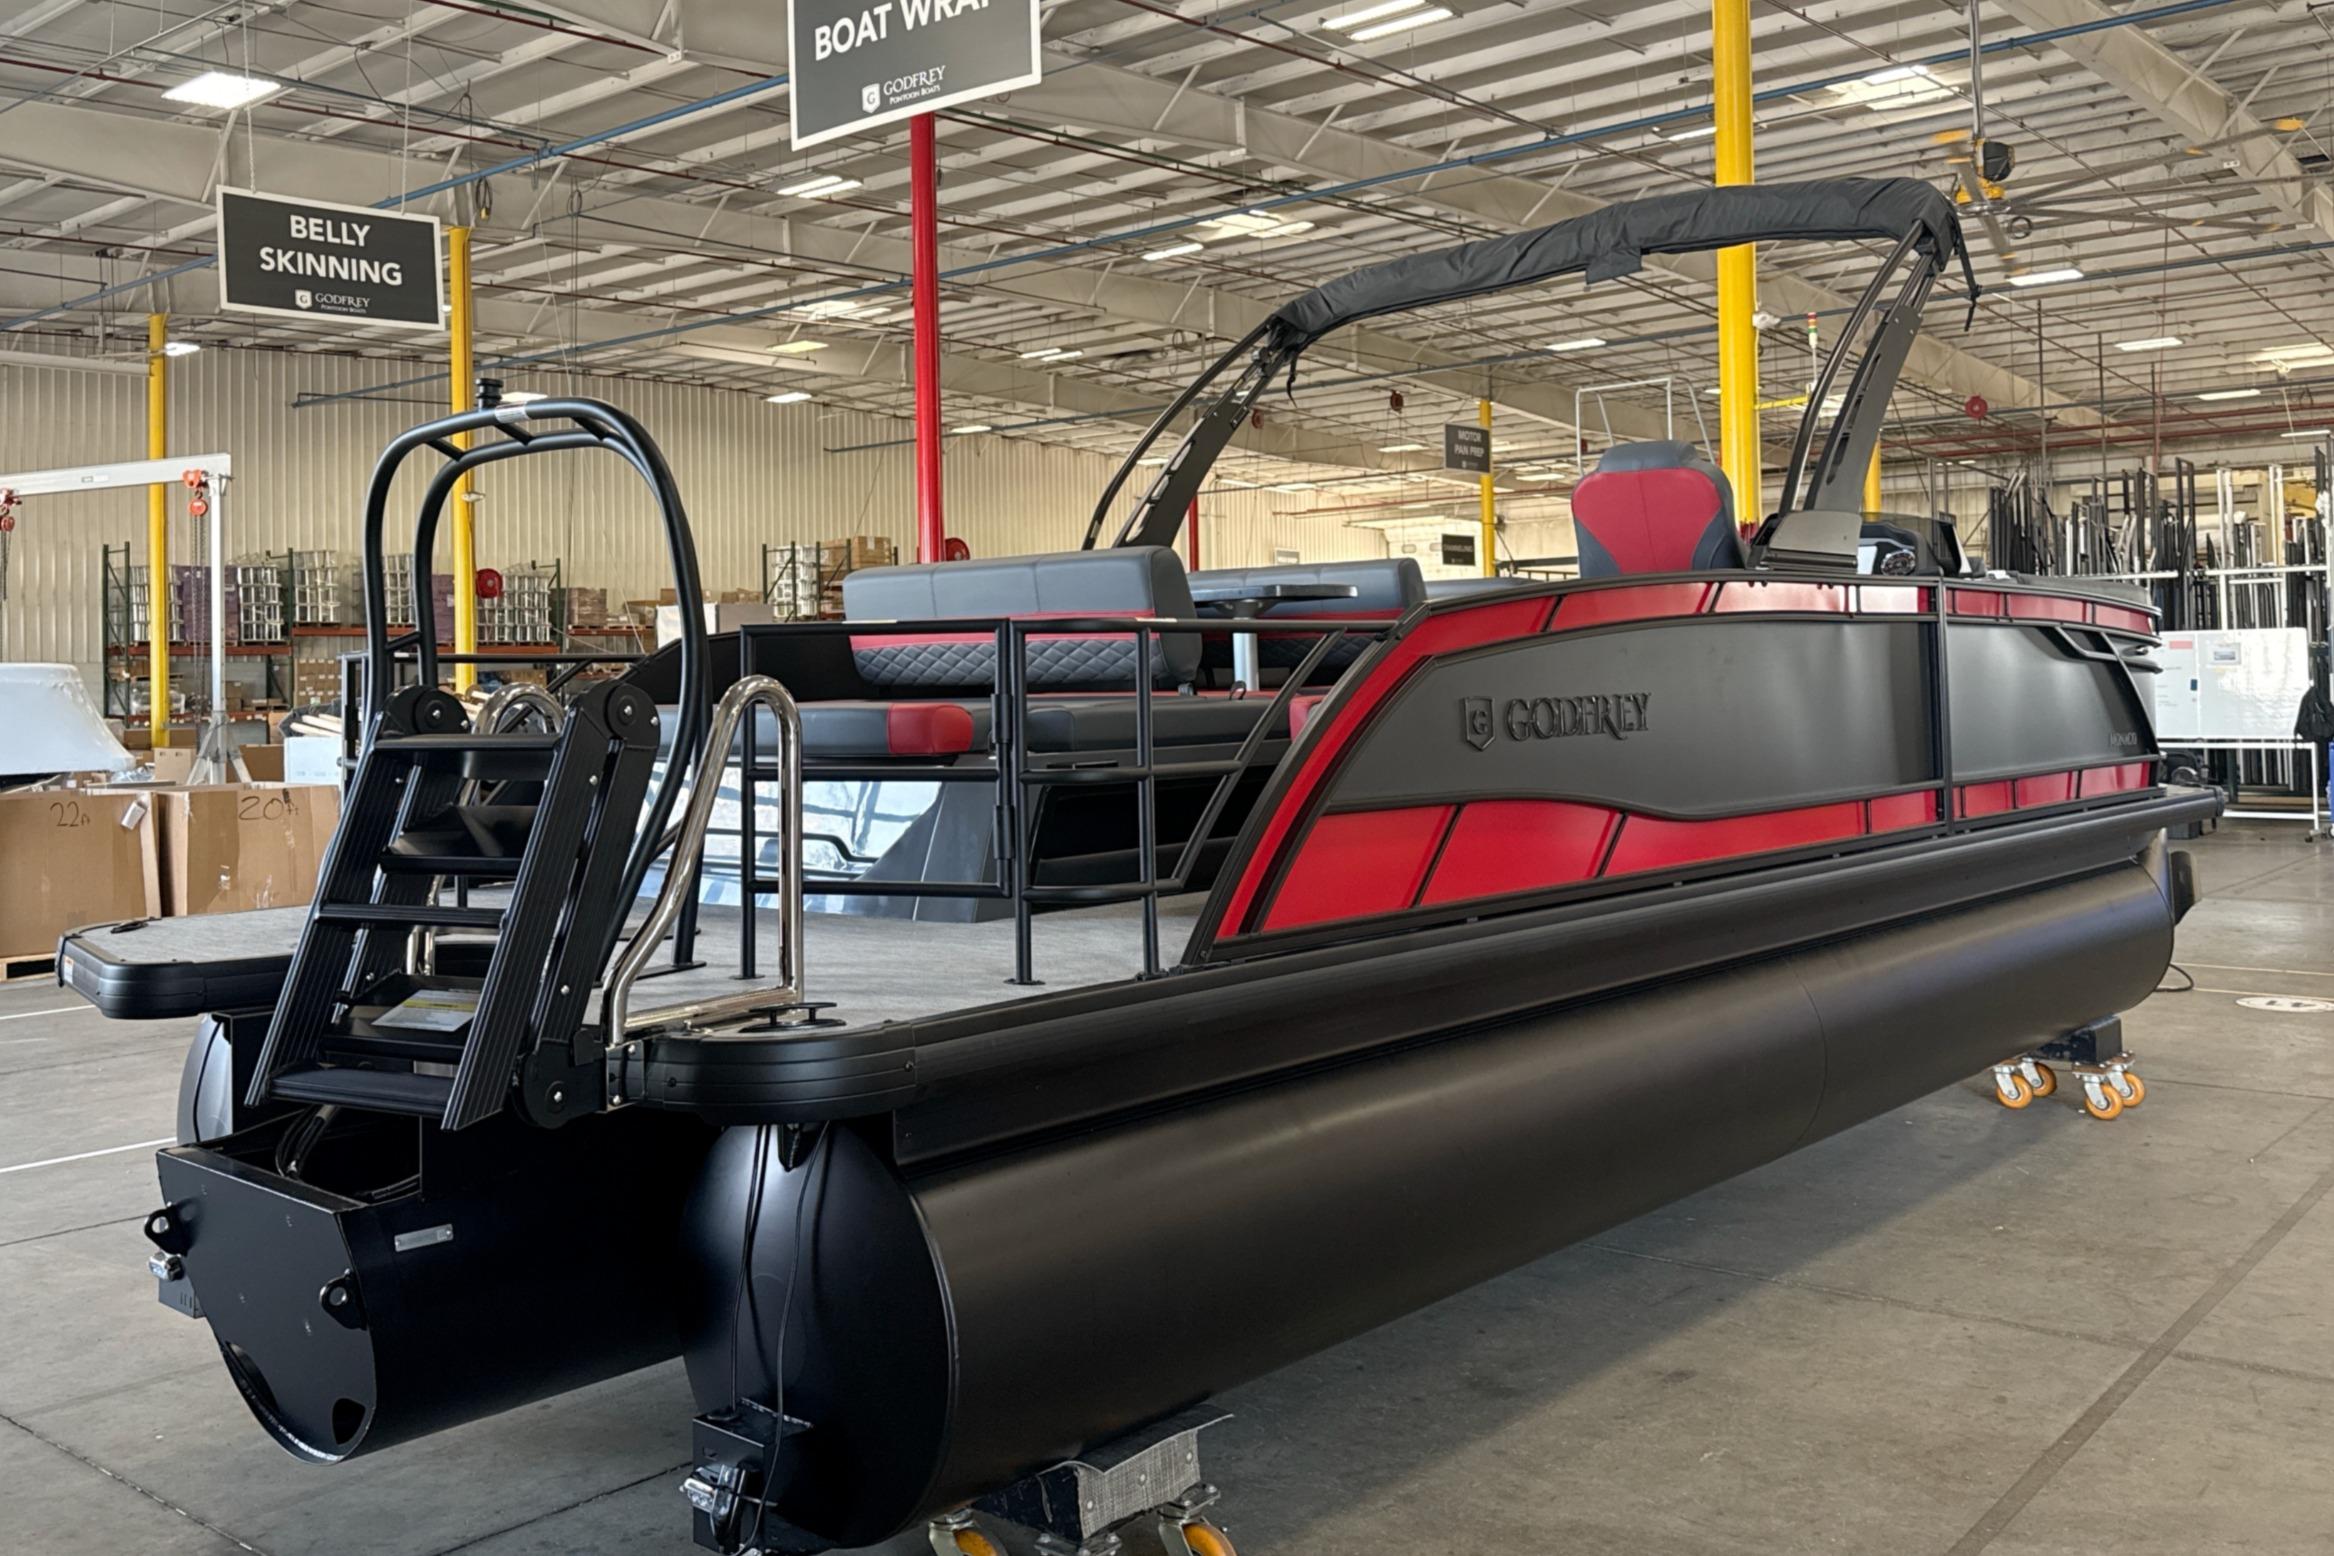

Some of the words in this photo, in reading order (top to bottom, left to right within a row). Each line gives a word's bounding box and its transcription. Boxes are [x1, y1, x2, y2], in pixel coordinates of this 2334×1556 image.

[814, 2, 893, 61] BOAT
[900, 0, 989, 31] WRA
[882, 65, 946, 95] GODFREY
[289, 214, 370, 247] BELLY
[259, 246, 403, 286] SKINNING
[314, 292, 371, 308] GODFREY
[1506, 693, 1652, 741] GODFREY
